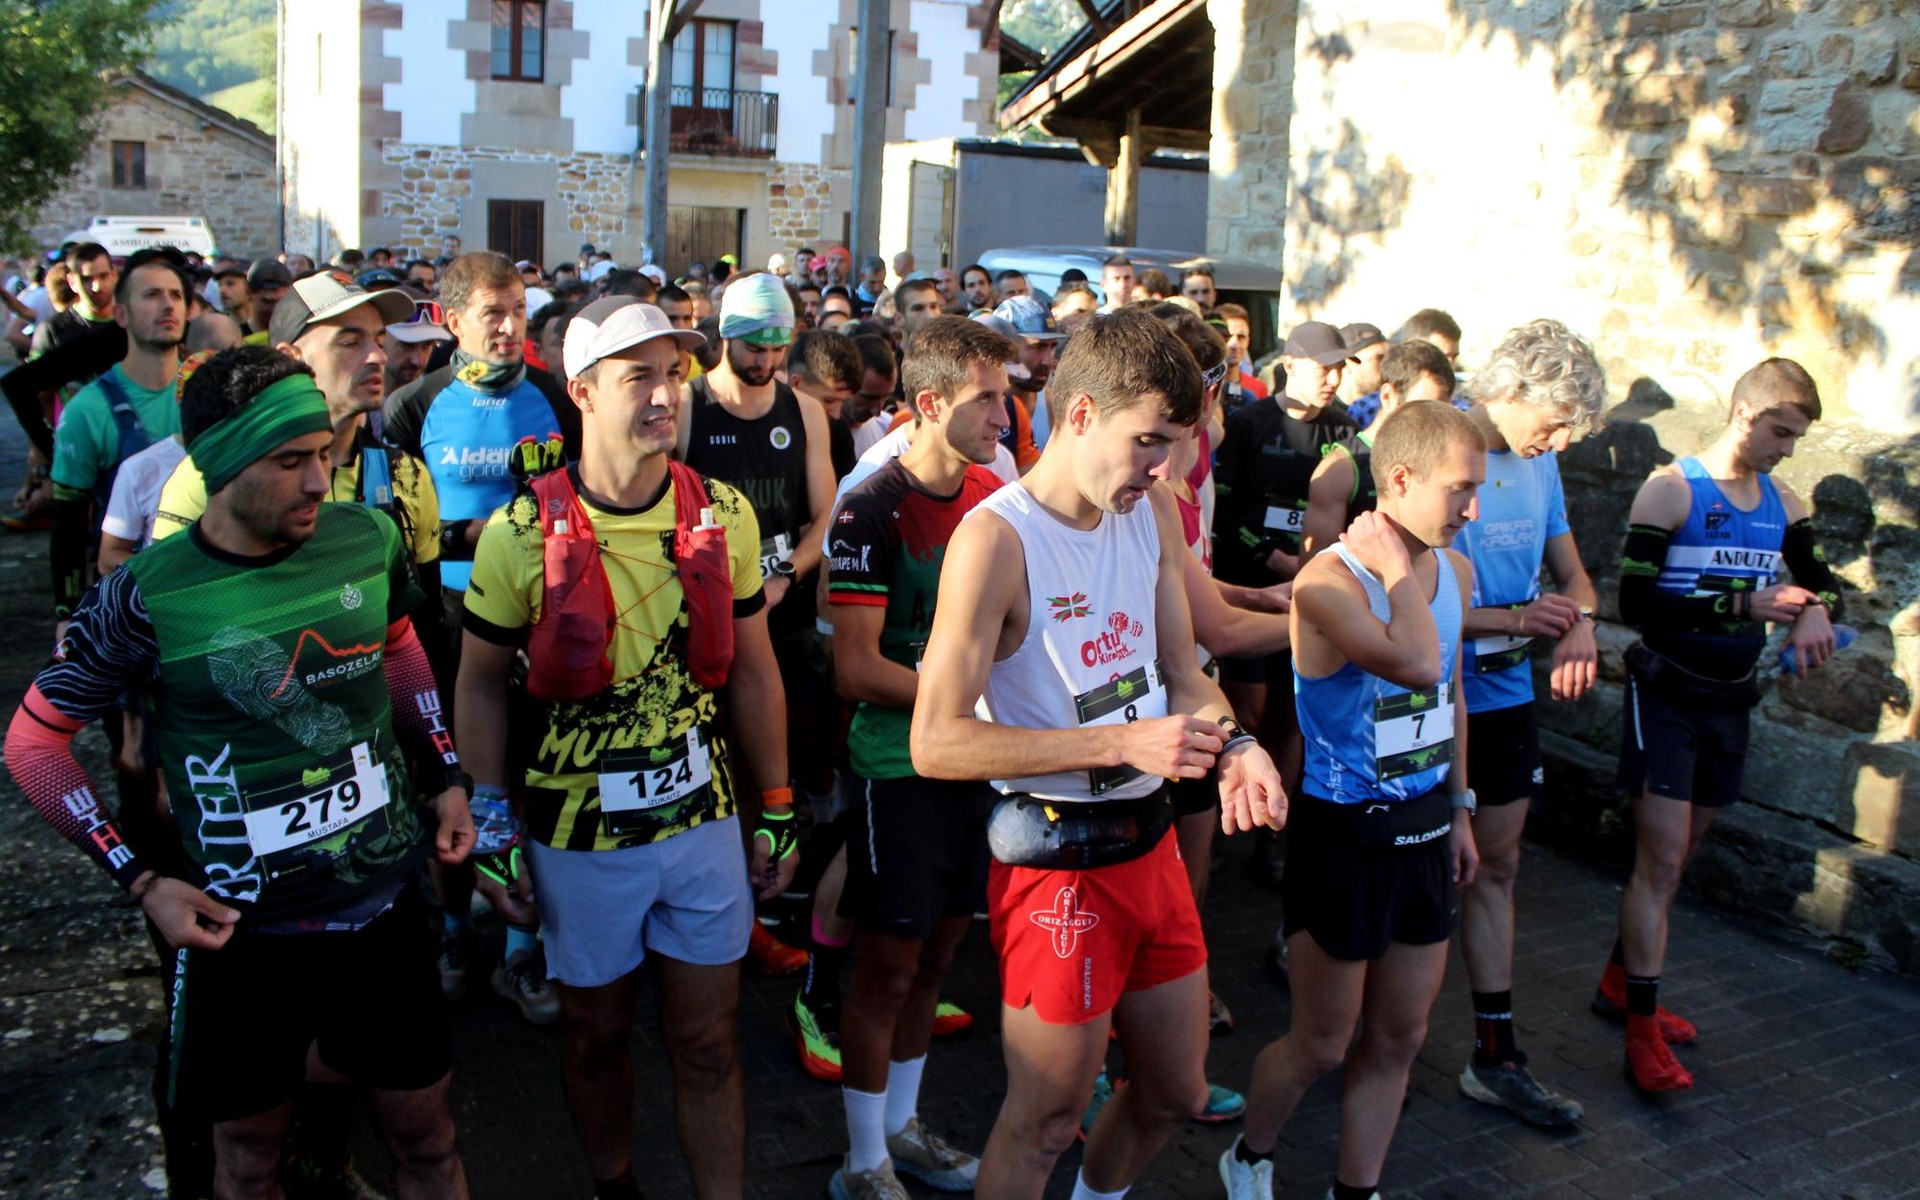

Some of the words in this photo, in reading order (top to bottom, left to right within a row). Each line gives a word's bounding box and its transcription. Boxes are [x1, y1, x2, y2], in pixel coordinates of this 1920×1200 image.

[110, 238, 190, 249] AMBULANCIA
[1710, 549, 1774, 569] ANDUTZ
[1411, 714, 1425, 739] 7
[628, 757, 693, 800] 124
[280, 780, 361, 836] 279
[647, 791, 681, 807] IZUKAITZ
[307, 817, 349, 840] MUSTAFA
